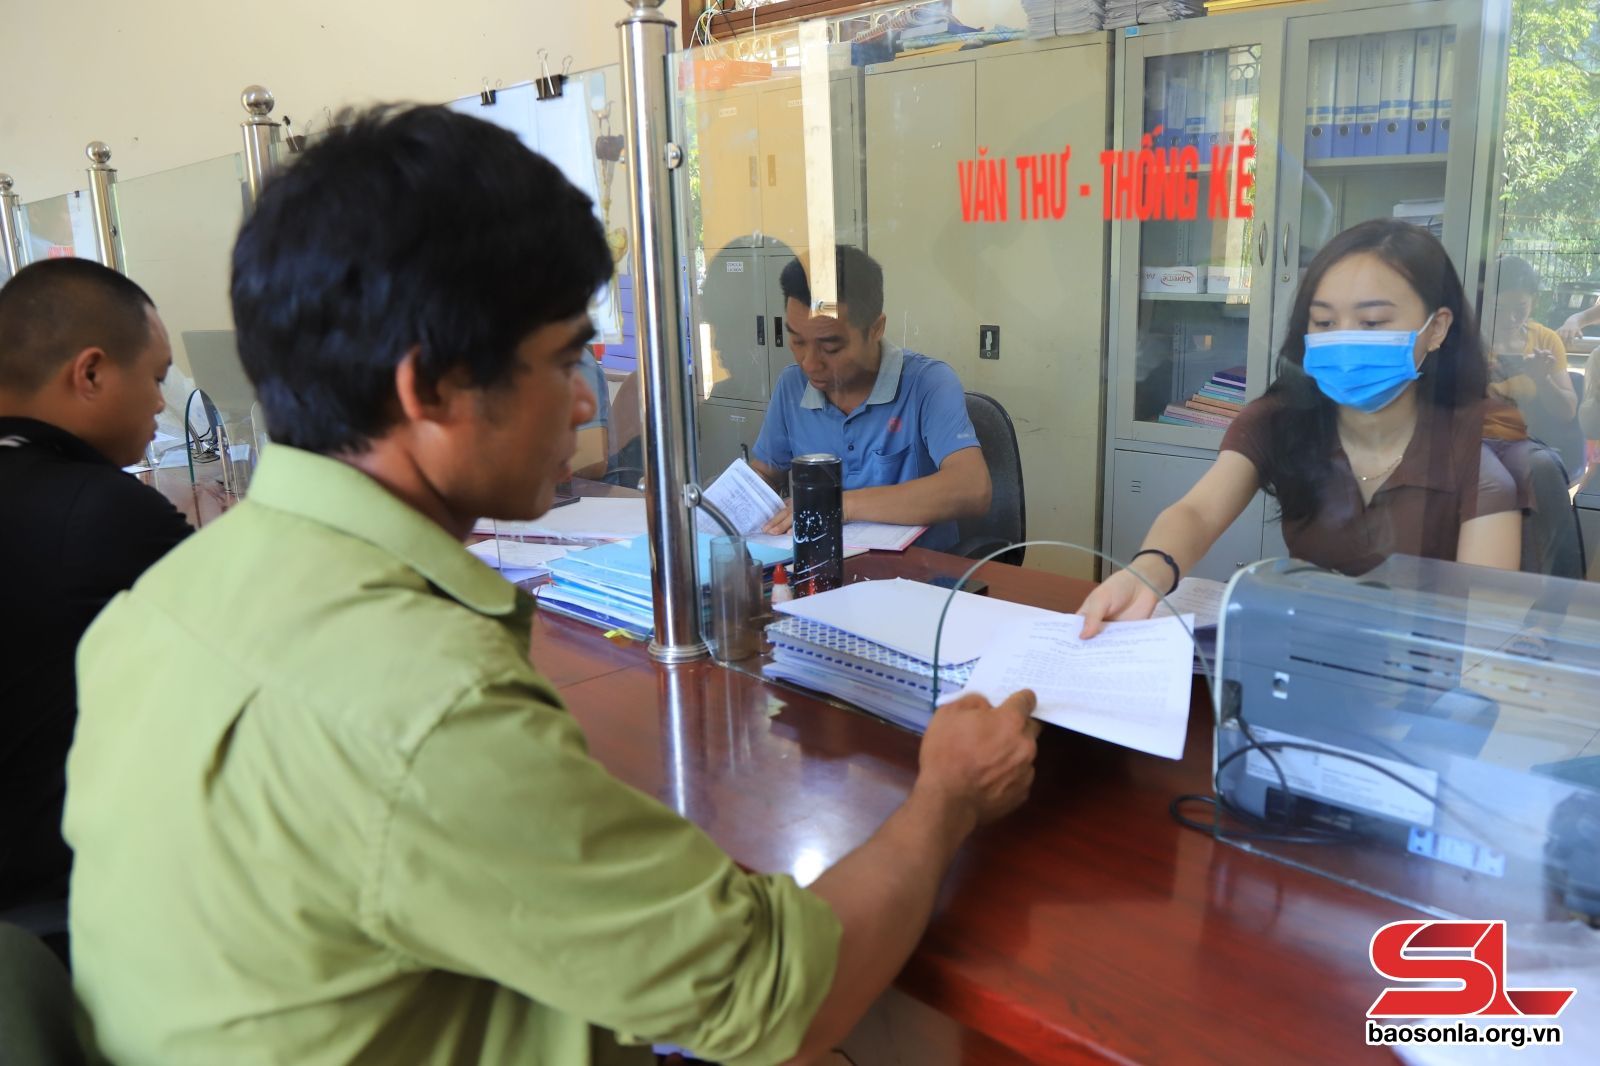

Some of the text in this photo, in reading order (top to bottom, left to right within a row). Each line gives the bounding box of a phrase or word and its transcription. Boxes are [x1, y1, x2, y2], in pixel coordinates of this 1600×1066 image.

[957, 124, 1256, 223] VĂN THƯ - THỐNG KÊ
[1162, 274, 1192, 284] Supreme
